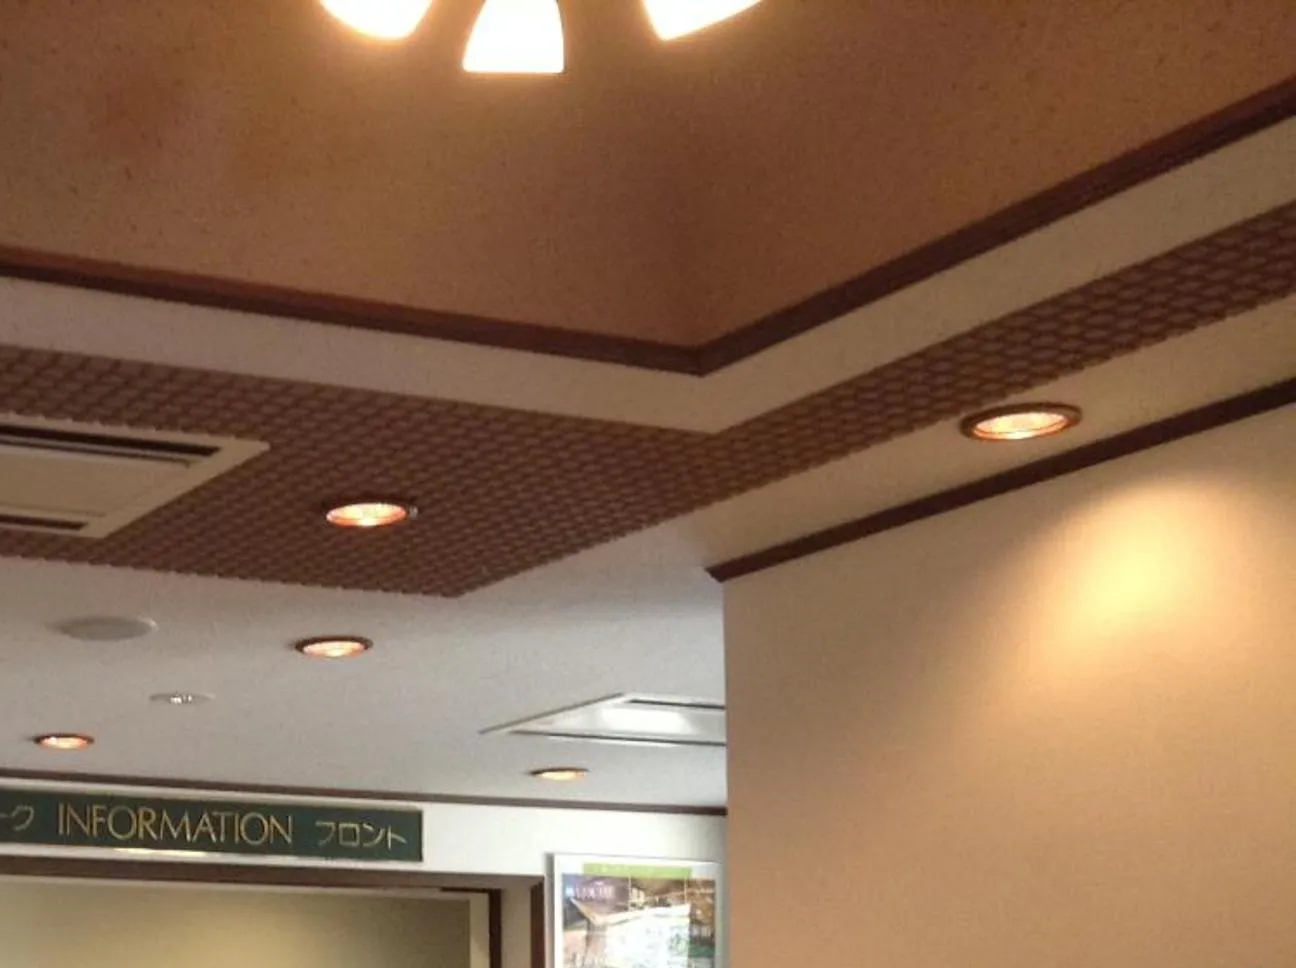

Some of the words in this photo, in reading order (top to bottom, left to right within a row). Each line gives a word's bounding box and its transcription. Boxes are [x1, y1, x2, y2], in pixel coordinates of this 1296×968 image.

[57, 802, 293, 845] INFORMATION
[314, 819, 408, 850] フロント
